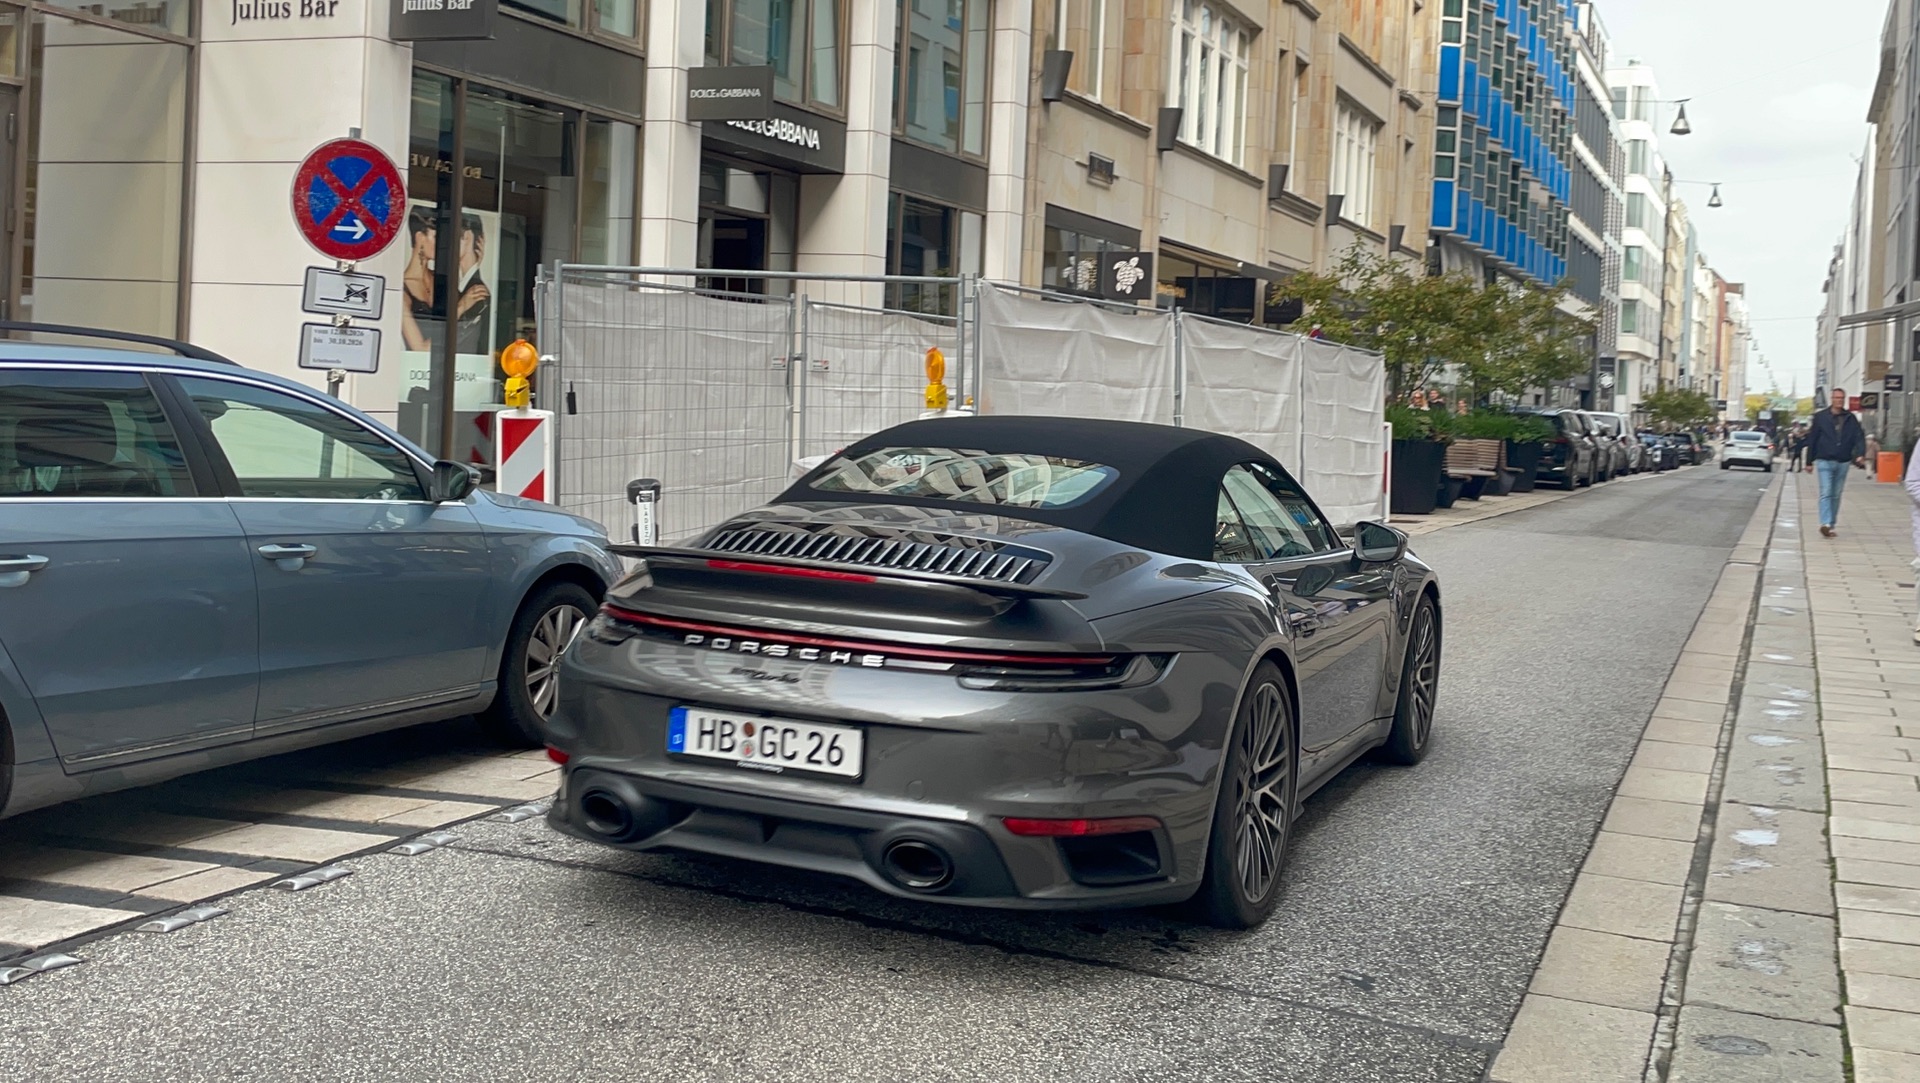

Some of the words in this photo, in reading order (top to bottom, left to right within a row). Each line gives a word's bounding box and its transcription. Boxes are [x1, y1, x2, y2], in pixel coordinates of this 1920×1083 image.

[231, 0, 291, 26] Julius
[690, 88, 761, 99] DOLCE&GABBANA
[684, 634, 885, 668] PORSCHE
[696, 717, 735, 753] HB
[759, 726, 798, 761] GC
[805, 731, 844, 766] 26
